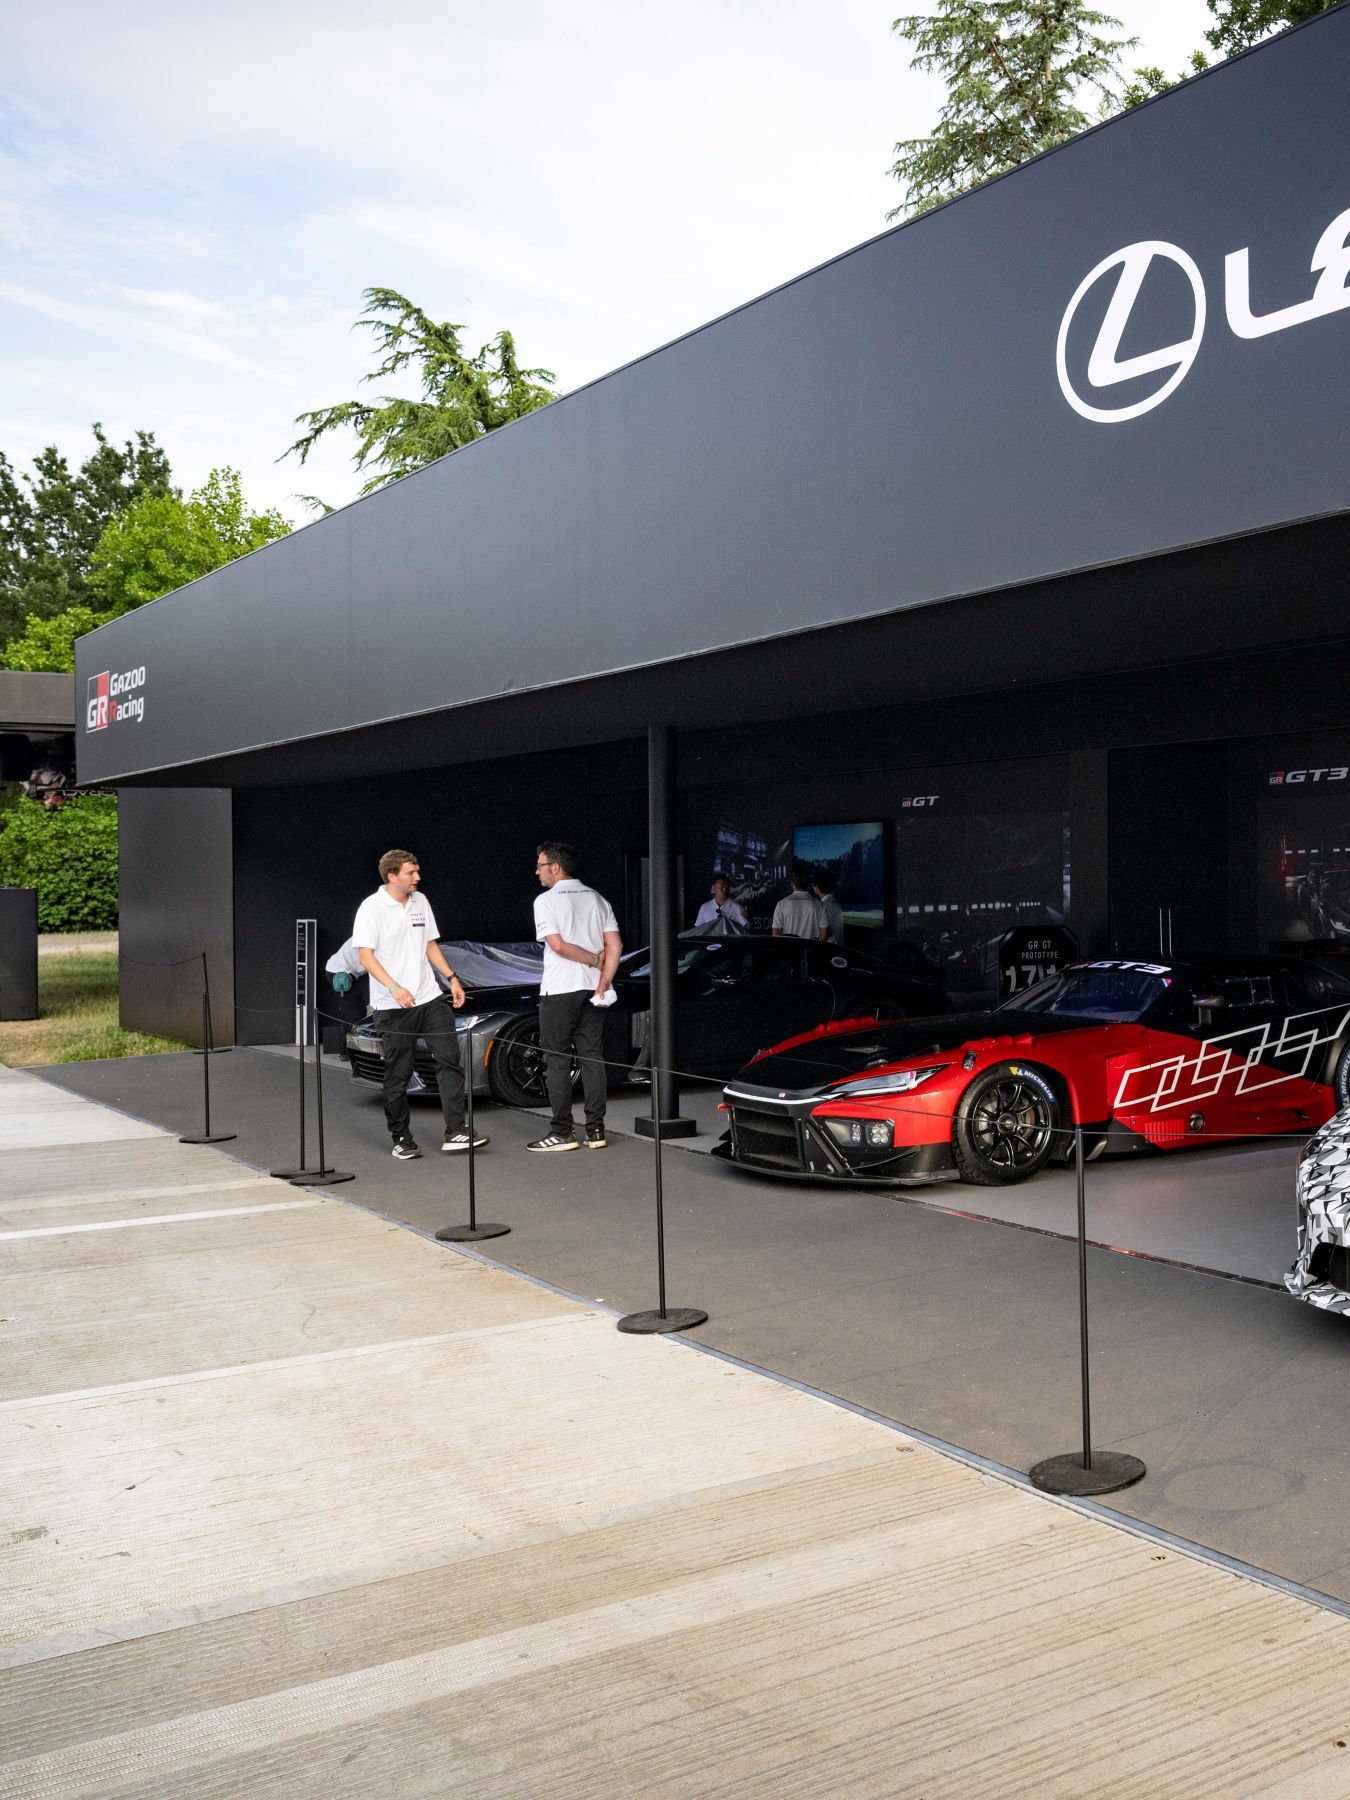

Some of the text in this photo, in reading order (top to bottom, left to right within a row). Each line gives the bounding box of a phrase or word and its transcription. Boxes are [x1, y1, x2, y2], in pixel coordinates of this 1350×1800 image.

[88, 666, 146, 728] GR GAZOO
[109, 695, 145, 722] Racing
[1285, 767, 1349, 783] GT3
[912, 795, 940, 807] GT
[1028, 939, 1052, 950] GR GT
[1021, 951, 1059, 960] PROTOTYPE
[1087, 960, 1172, 975] GT3
[1023, 1070, 1055, 1099] MICHELIN
